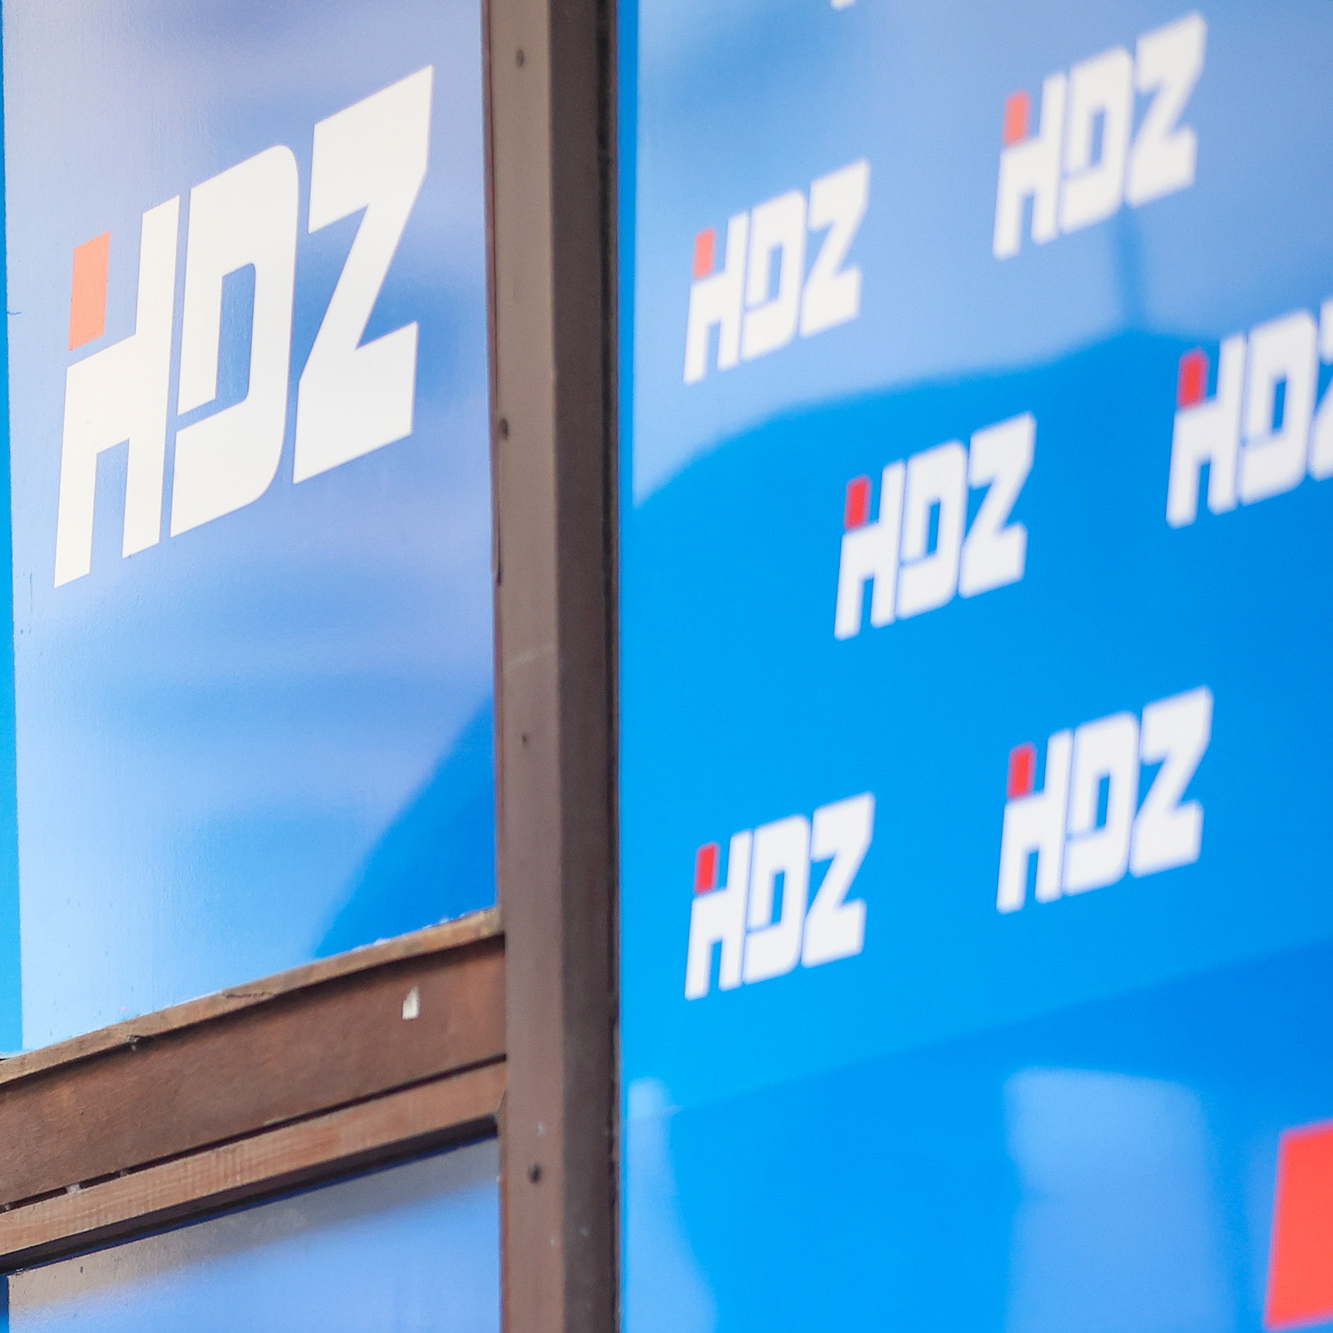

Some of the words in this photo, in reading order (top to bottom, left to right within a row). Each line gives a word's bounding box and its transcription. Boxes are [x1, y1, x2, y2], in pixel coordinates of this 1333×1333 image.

[993, 15, 1206, 259] HDZ
[54, 65, 434, 588] HDZ
[684, 160, 870, 384] HDZ
[835, 414, 1036, 639] HDZ
[685, 793, 875, 1000] HDZ
[997, 688, 1213, 912] HDZ
